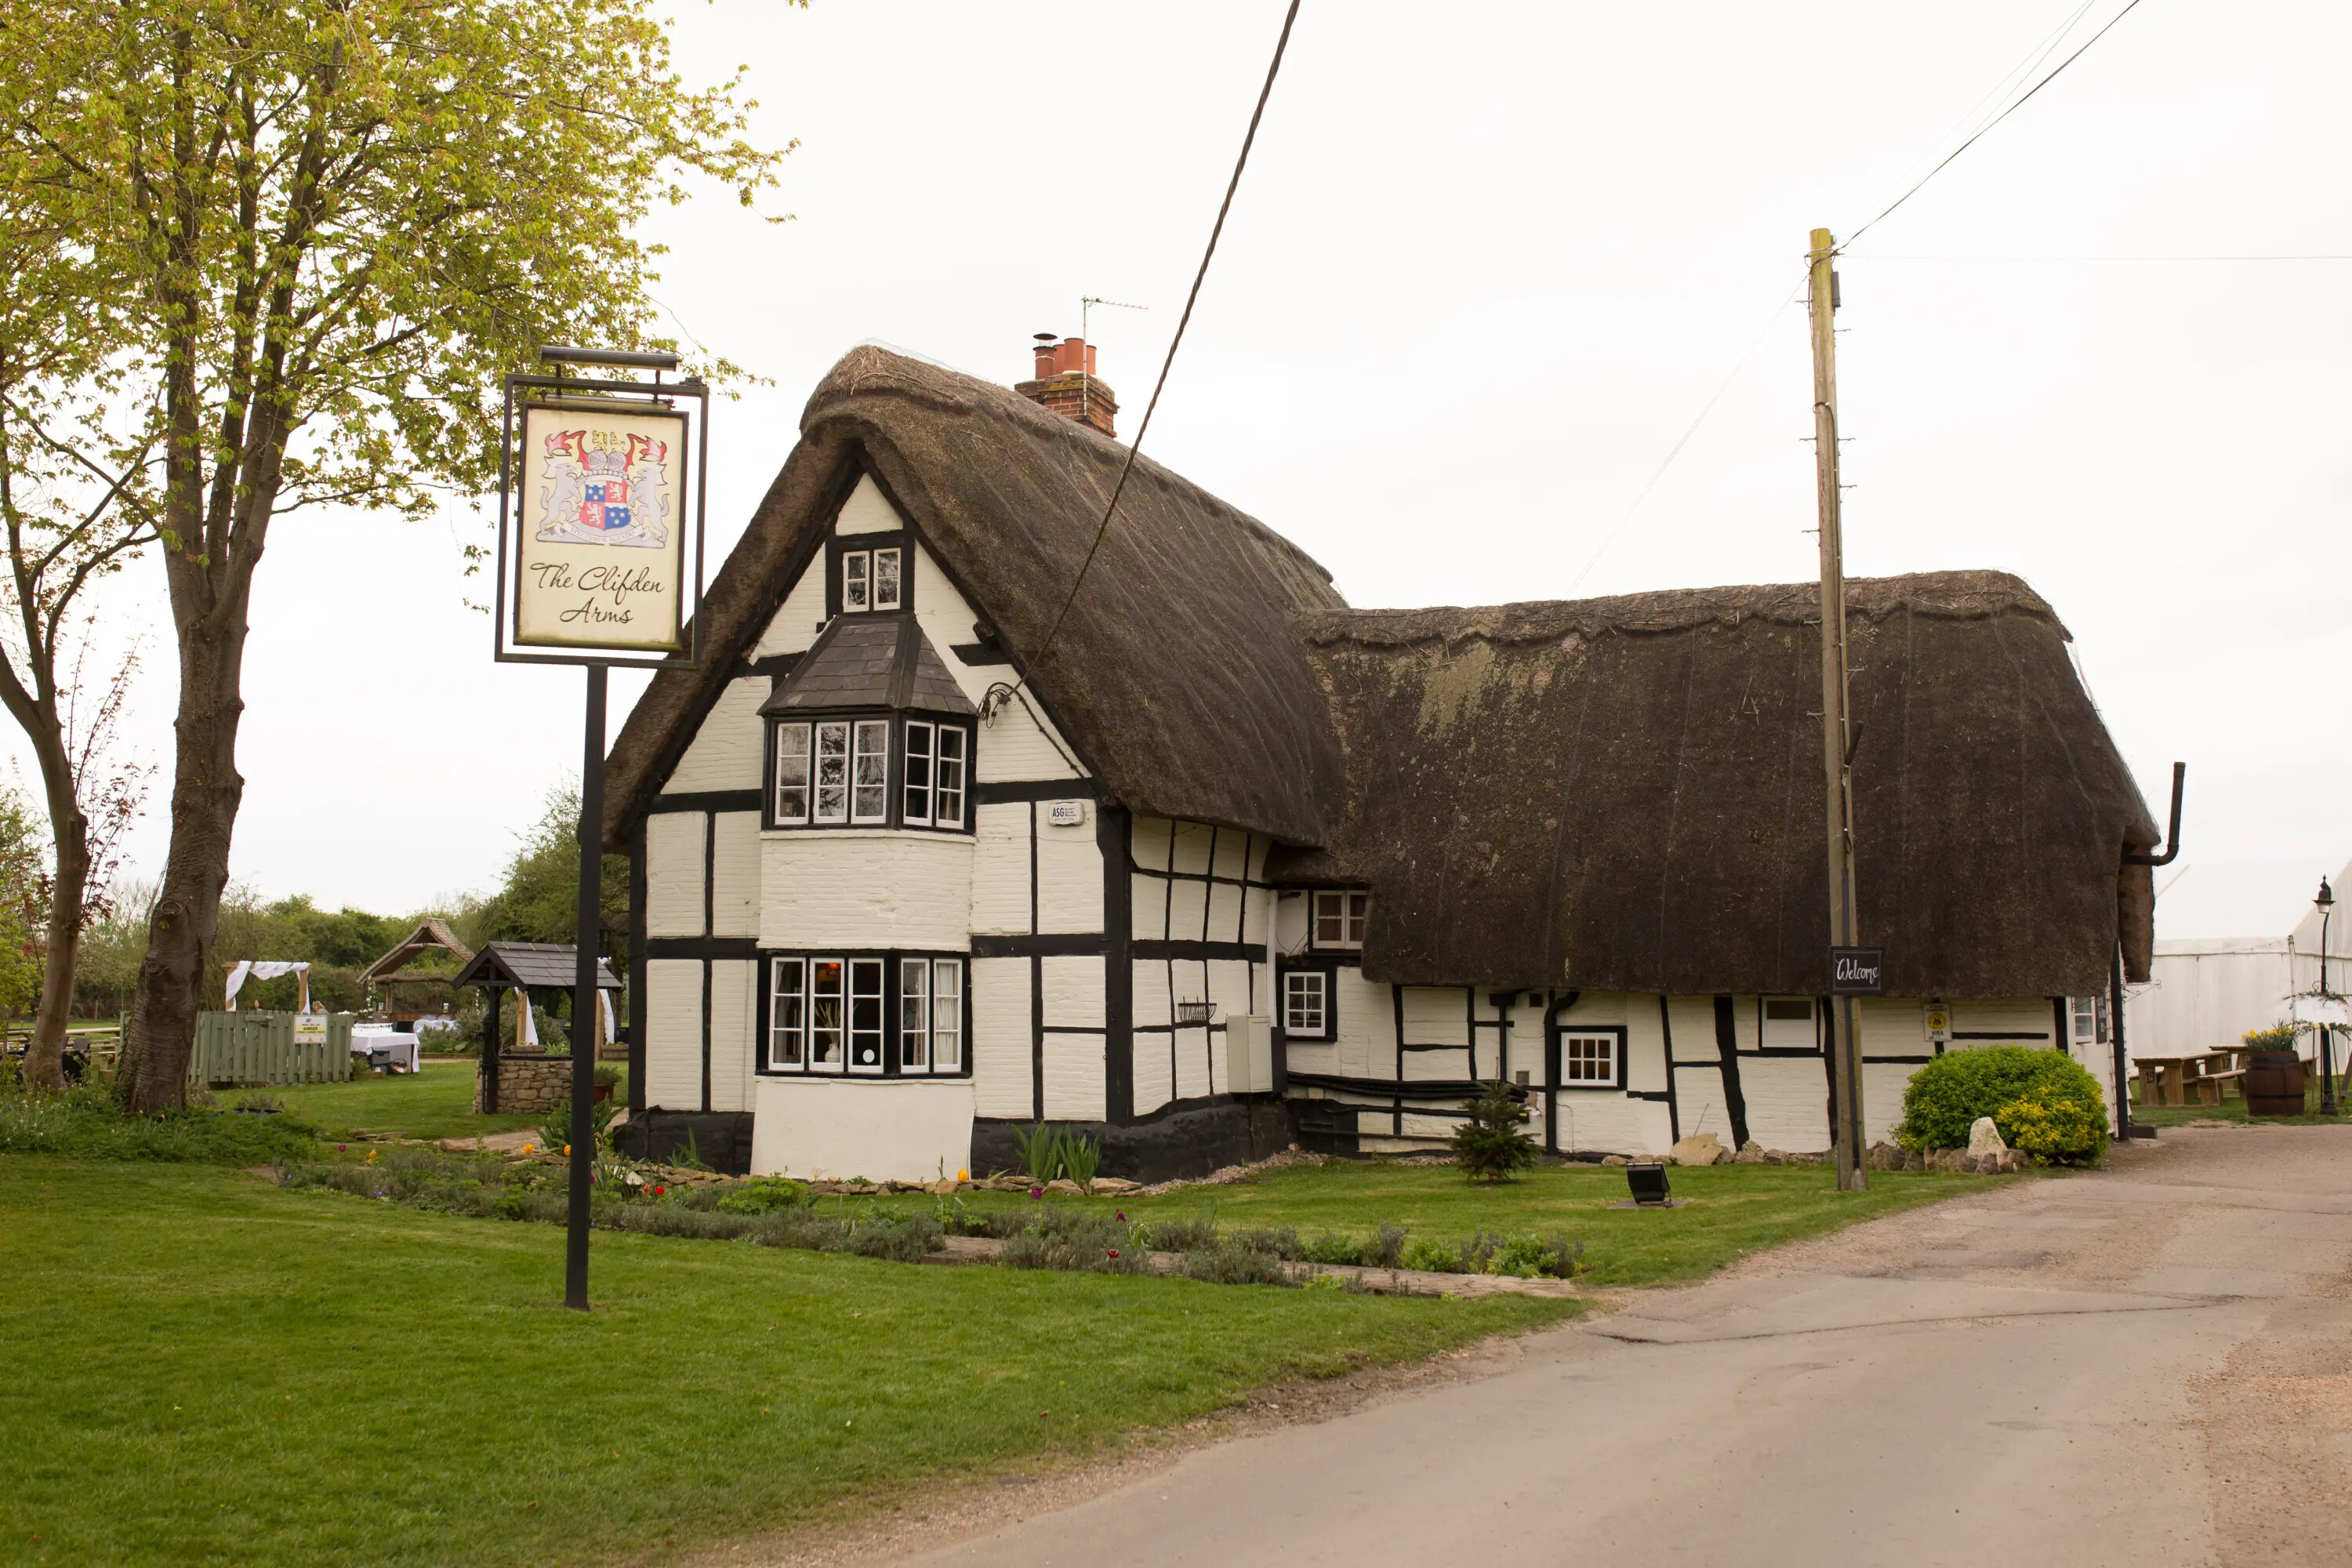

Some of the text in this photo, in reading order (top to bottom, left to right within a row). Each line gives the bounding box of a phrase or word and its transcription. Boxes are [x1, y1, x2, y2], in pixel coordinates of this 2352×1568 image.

[530, 563, 665, 604] The Clifden
[560, 597, 633, 624] Arms
[1052, 808, 1065, 817] ASG
[1835, 958, 1878, 984] Welcome
[2223, 1058, 2230, 1069] 17
[2146, 1071, 2155, 1083] 19
